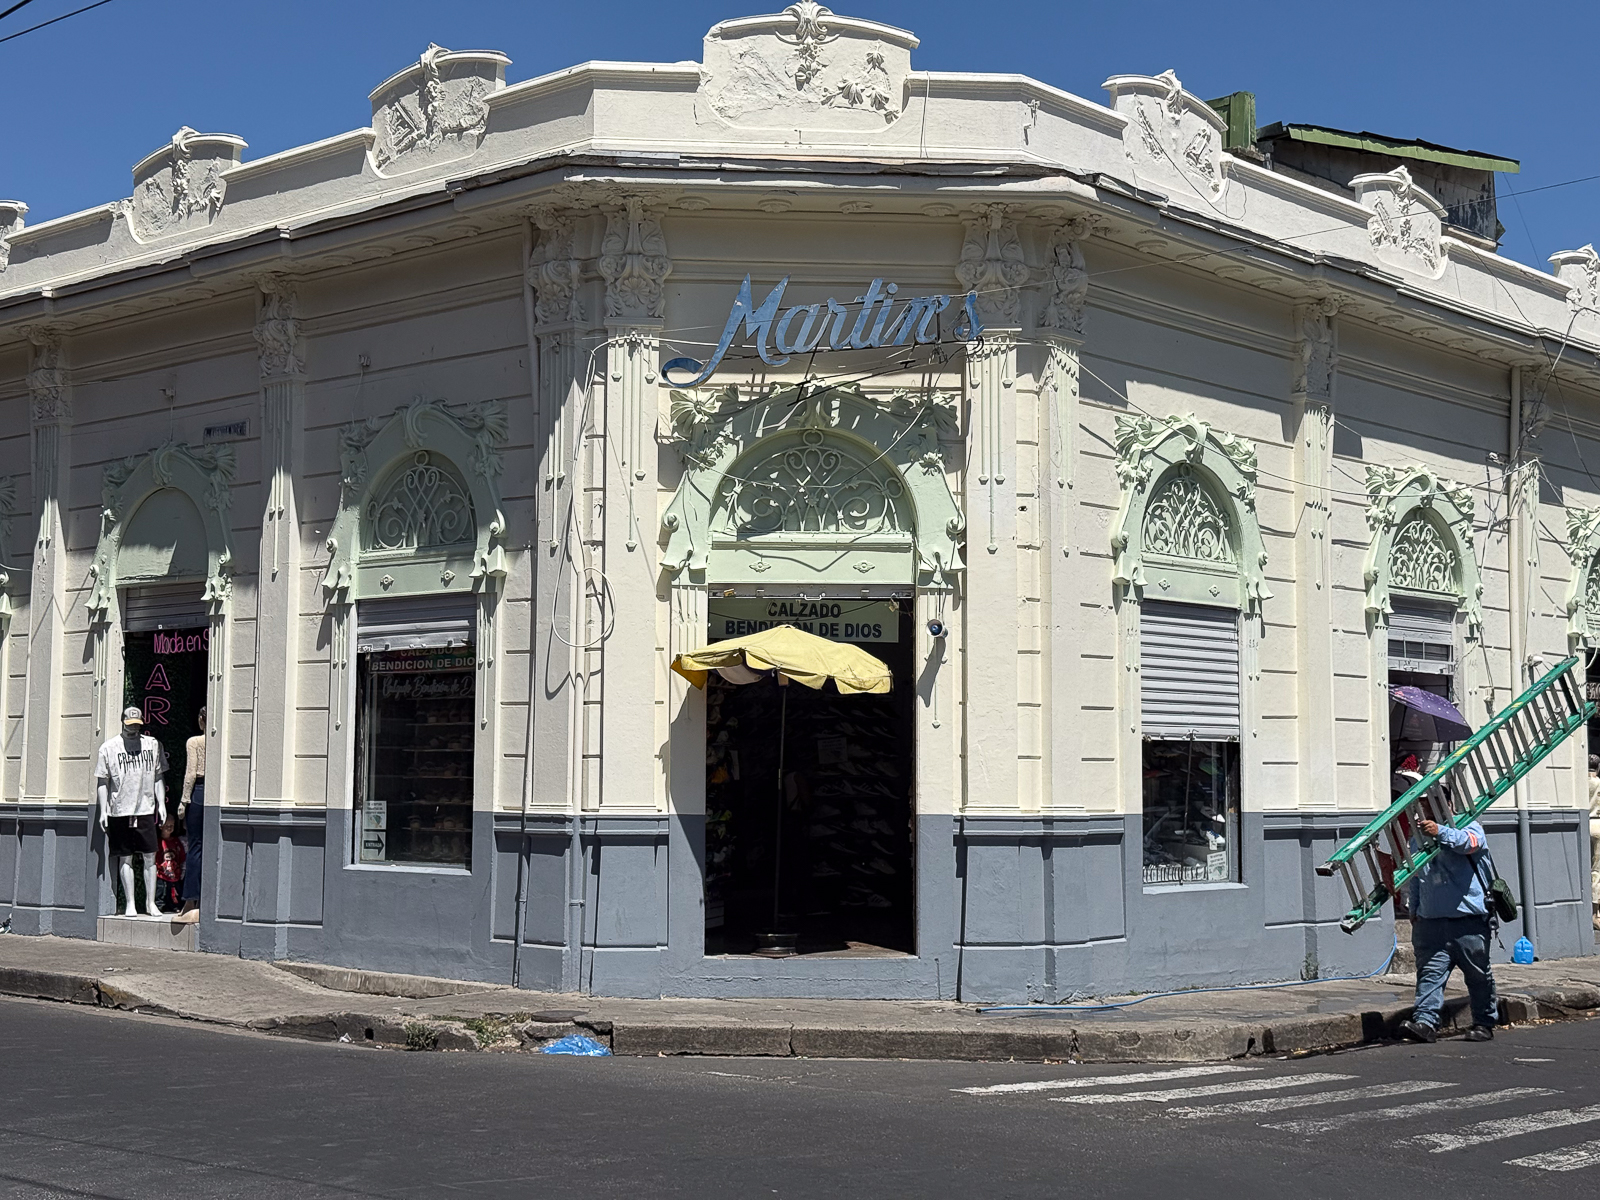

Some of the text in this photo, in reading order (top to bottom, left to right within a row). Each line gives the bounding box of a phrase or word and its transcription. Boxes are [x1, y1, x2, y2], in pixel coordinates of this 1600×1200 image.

[767, 601, 842, 618] CALZADO
[818, 623, 840, 637] DE
[844, 623, 882, 638] DIOS
[154, 631, 184, 654] Moda
[186, 633, 201, 652] en
[371, 659, 433, 671] BENDICION
[436, 658, 452, 669] DE
